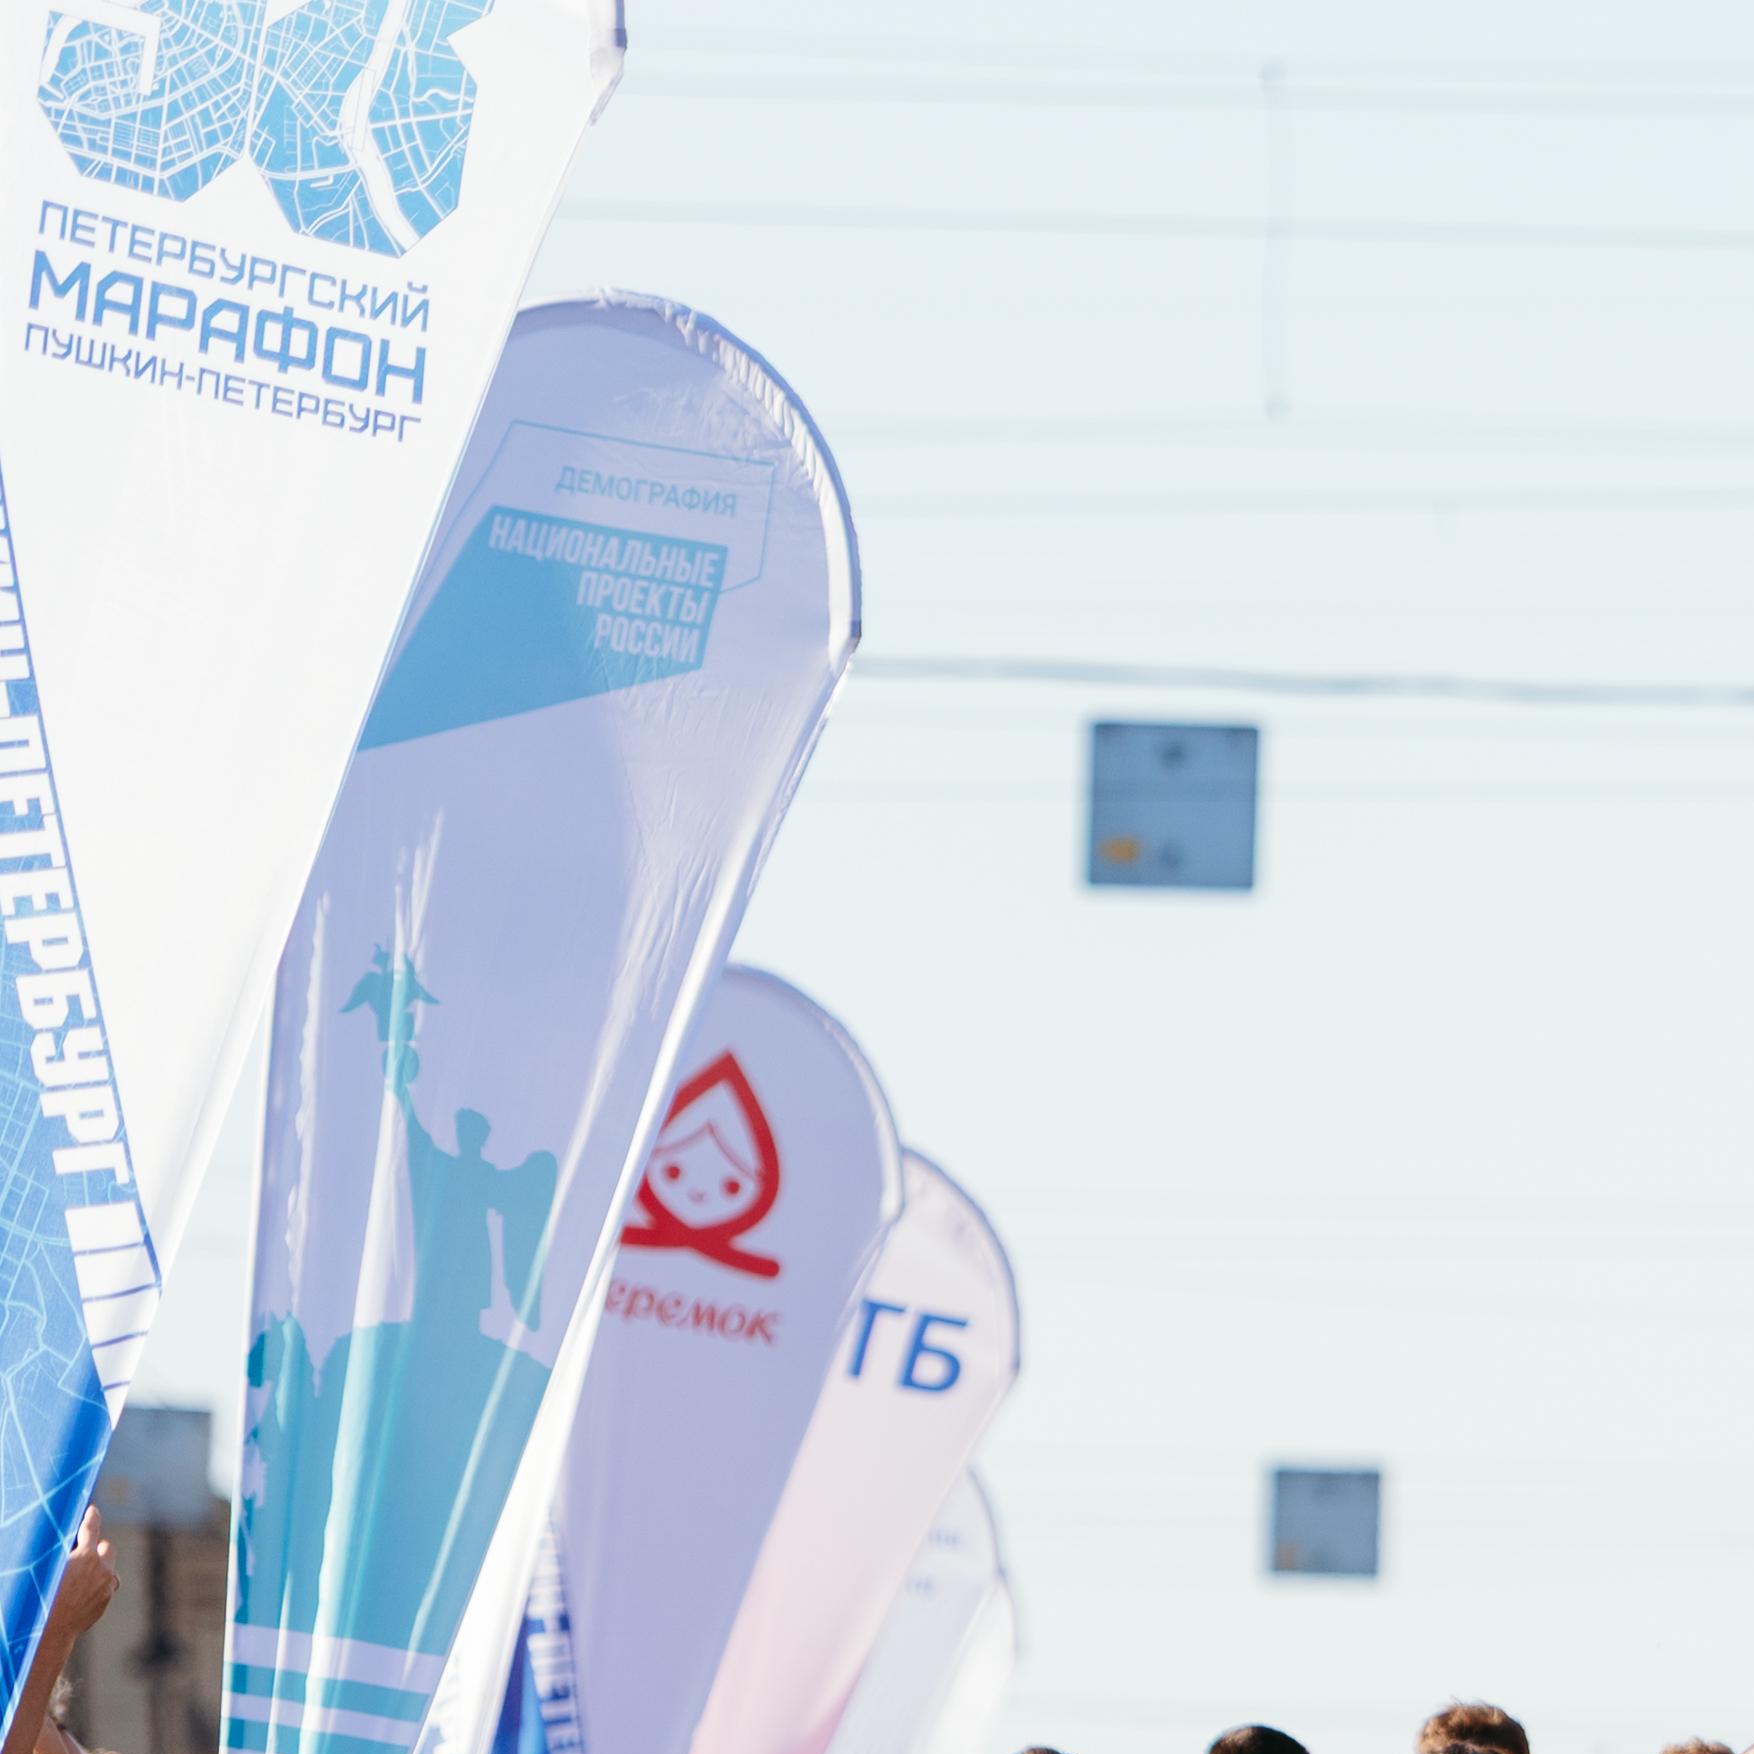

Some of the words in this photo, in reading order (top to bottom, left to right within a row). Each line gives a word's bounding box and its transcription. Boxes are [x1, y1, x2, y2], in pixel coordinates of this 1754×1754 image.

[38, 200, 431, 332] ПЕТЕРБУРГСКИЙ
[27, 250, 427, 404] МАРАФОН
[24, 323, 422, 443] ПУШКИН-ПЕТЕРБУРГ
[554, 465, 738, 519] ДЕМОГРАФИЯ
[489, 513, 721, 591] НАЦИОНАЛЬНЫЕ
[576, 573, 710, 626] ПРОЕКТЫ
[595, 612, 701, 665] РОССИИ
[845, 1298, 972, 1395] ТБ
